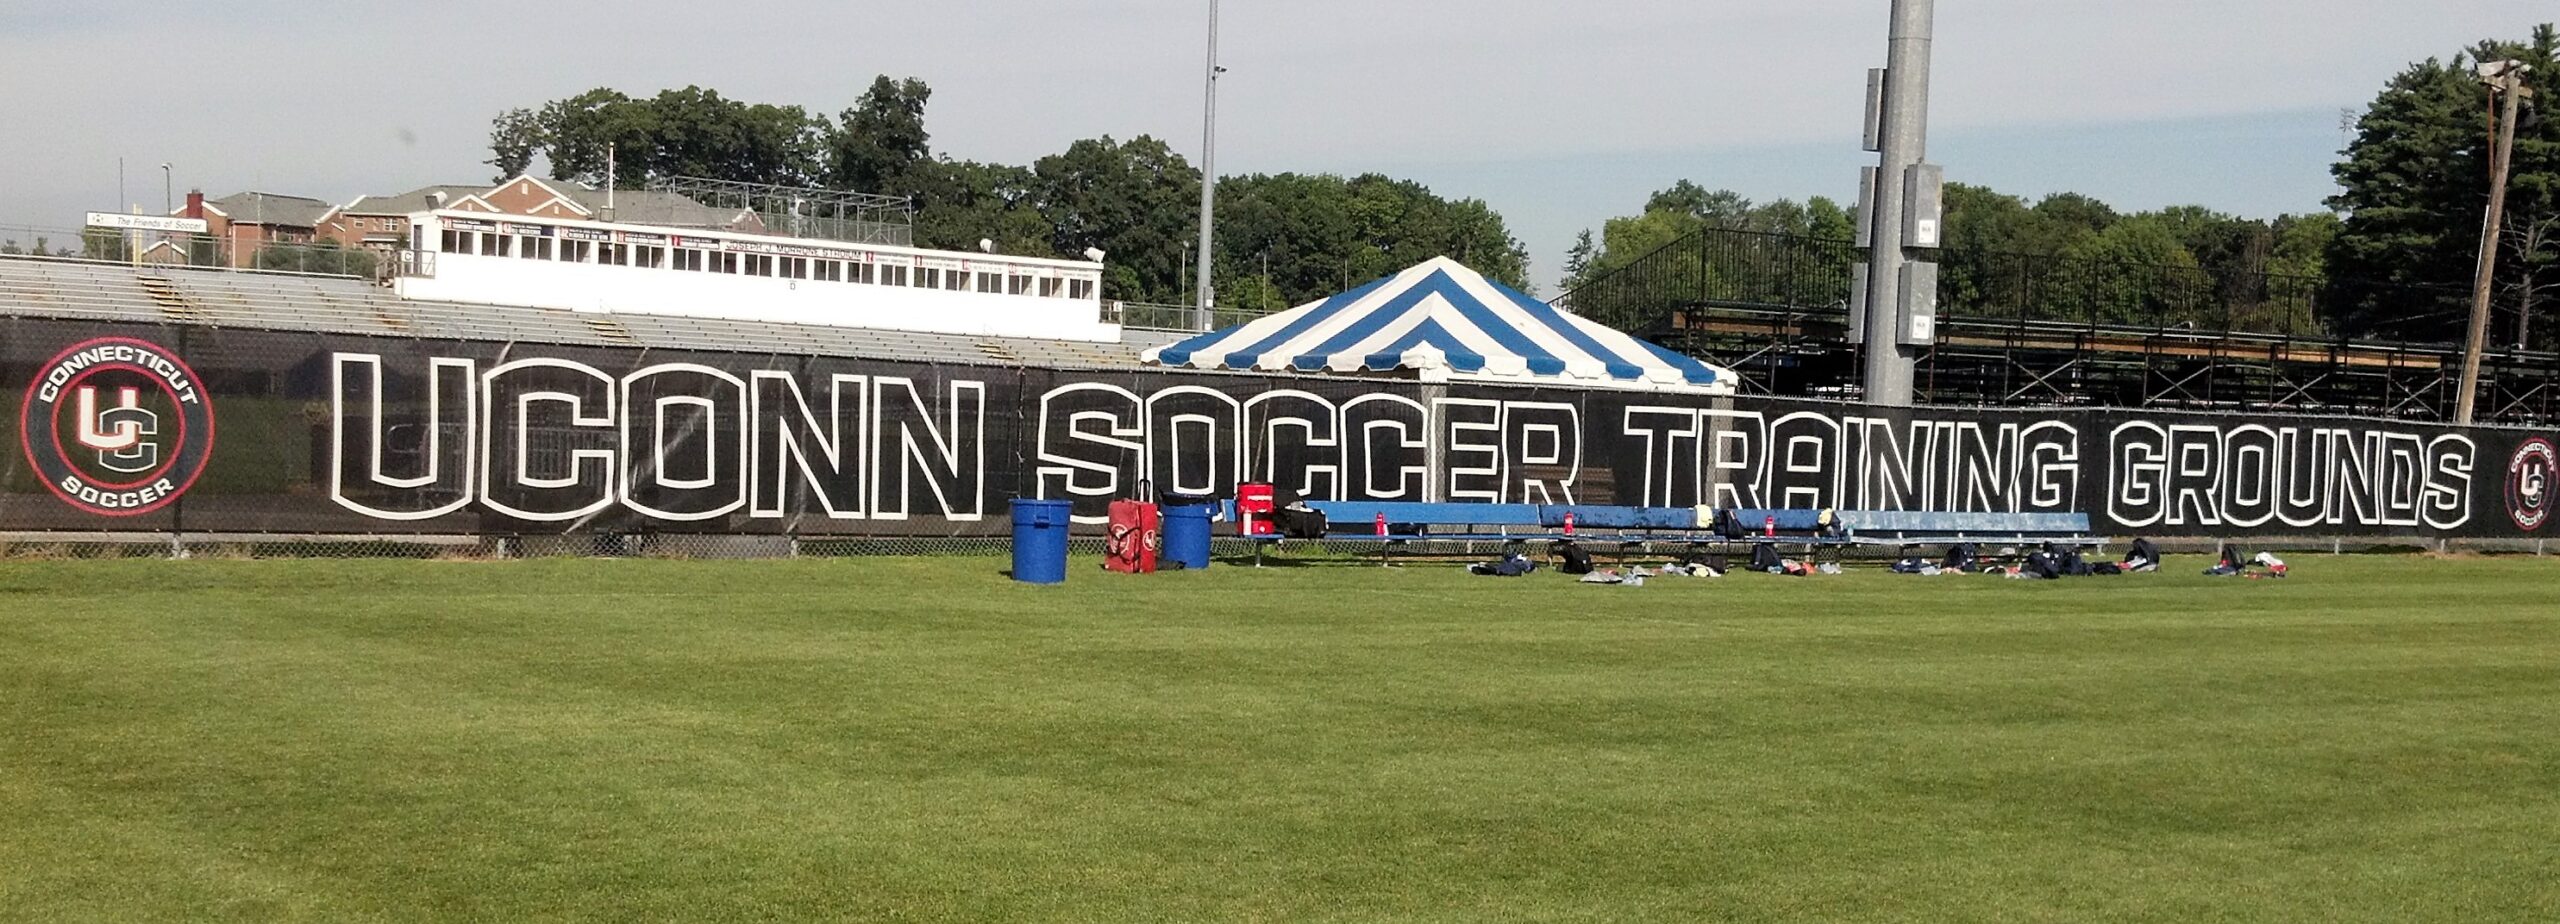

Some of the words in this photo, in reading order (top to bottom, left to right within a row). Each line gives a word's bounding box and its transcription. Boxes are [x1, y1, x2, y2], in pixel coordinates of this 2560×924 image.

[117, 217, 130, 226] The
[133, 218, 161, 228] Friends
[175, 221, 202, 230] Soccer
[404, 252, 412, 261] C
[39, 345, 198, 404] CONNECTICUT
[332, 352, 985, 521] UCONN
[1036, 381, 1581, 524] SOCCER
[1623, 406, 2079, 513] TRAINING
[2107, 420, 2476, 530] GROUNDS
[61, 476, 174, 508] SOCCER
